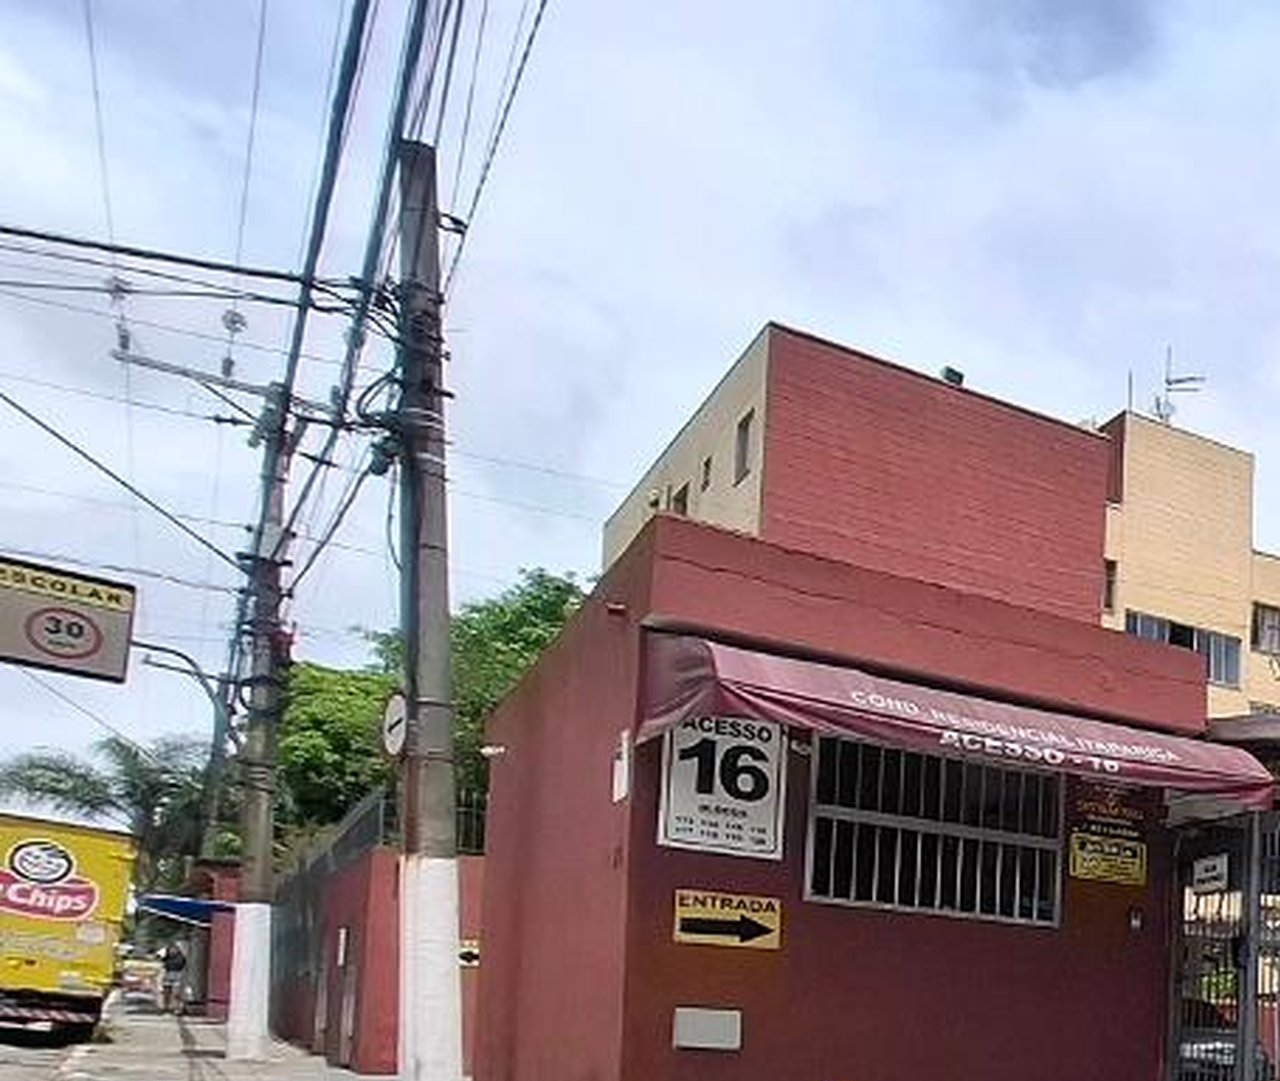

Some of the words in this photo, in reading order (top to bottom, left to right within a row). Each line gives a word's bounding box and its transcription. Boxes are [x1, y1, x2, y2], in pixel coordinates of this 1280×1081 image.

[44, 616, 84, 639] 30
[682, 716, 772, 743] ACESSO
[939, 731, 1064, 764] ACESSO
[679, 738, 769, 802] 16
[8, 884, 87, 911] Chips
[679, 894, 777, 913] ENTRADA
